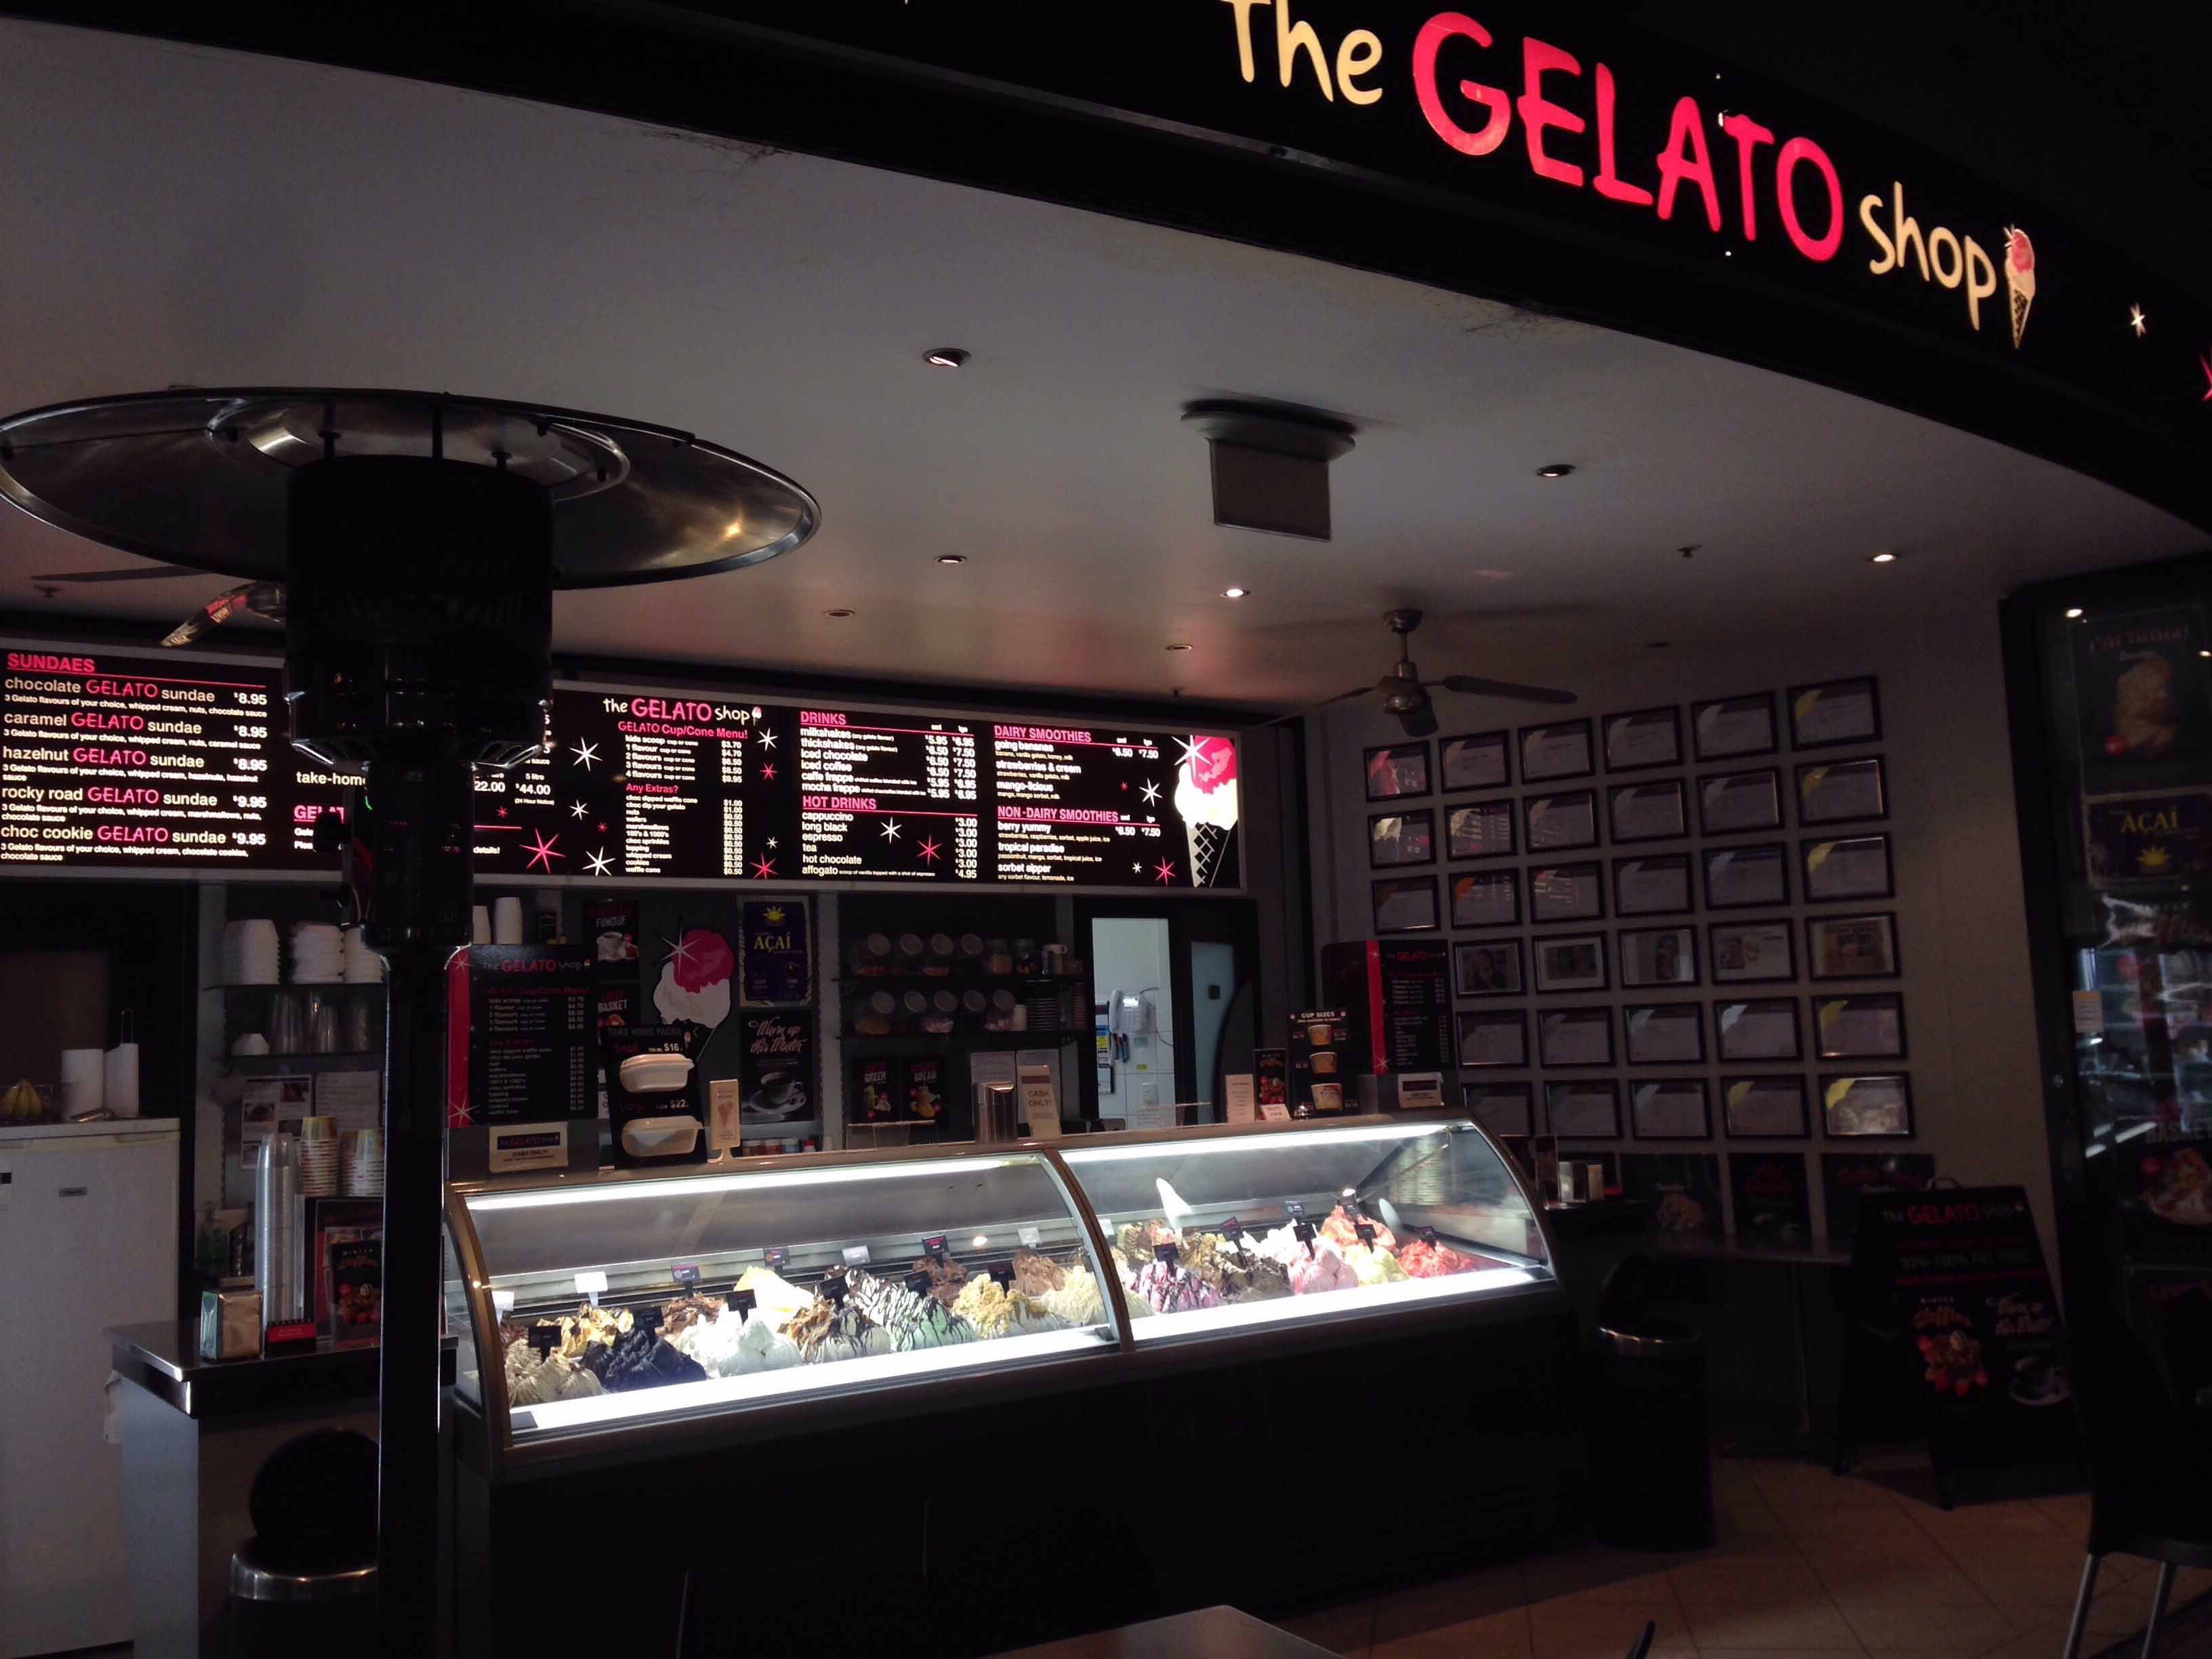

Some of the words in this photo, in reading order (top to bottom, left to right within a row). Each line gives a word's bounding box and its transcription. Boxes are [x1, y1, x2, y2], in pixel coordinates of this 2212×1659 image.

[1223, 0, 1383, 105] The
[1412, 12, 1843, 261] GELATO
[1860, 182, 1996, 331] shop
[8, 653, 95, 673] SUNDAES
[5, 677, 81, 693] chocolate
[86, 680, 158, 697] GELATO
[161, 689, 216, 702] sundae
[234, 692, 267, 705] $8.95
[12, 695, 37, 703] Gelato
[39, 696, 70, 705] flavours
[603, 699, 628, 712] the
[632, 698, 712, 721] GELATO
[714, 705, 750, 725] shop
[800, 711, 846, 725] DRINKS
[4, 713, 67, 726] caramel
[71, 712, 144, 730] GELATO
[148, 721, 202, 734] sundae
[234, 724, 267, 738] $8.95
[618, 721, 659, 733] GELATO
[661, 724, 714, 737] Cup/Cone
[716, 729, 748, 739] Menu!
[800, 726, 851, 739] milkshakes
[994, 725, 1027, 737] DAIRY
[1029, 727, 1091, 743] SMOOTHIES
[632, 743, 658, 752] flavour
[642, 737, 665, 745] scoop
[801, 737, 855, 750] thickshakes
[995, 739, 1018, 752] going
[1018, 741, 1054, 752] bananas
[3, 745, 69, 761] hazelnut
[73, 748, 146, 765] GELATO
[150, 754, 205, 768] sundae
[632, 752, 662, 761] flavours
[801, 748, 821, 758] iced
[823, 750, 868, 762] chocolate
[632, 761, 662, 770] flavours
[801, 760, 821, 770] iced
[823, 761, 853, 772] coffee
[996, 760, 1046, 771] strawberries
[1056, 764, 1082, 774] cream
[632, 770, 662, 779] flavours
[515, 783, 551, 795] $44.00
[626, 783, 643, 794] Any
[646, 784, 679, 793] Extras?
[1, 786, 45, 802] rocky
[49, 788, 83, 800] road
[87, 787, 159, 804] GELATO
[163, 793, 218, 806] sundae
[232, 795, 267, 808] $9.95
[802, 796, 828, 808] HOT
[831, 798, 877, 810] DRINKS
[802, 812, 854, 822] cappuccino
[955, 817, 978, 827] $3.00
[998, 806, 1021, 818] NON
[1059, 808, 1118, 822] SMOOTHIES
[802, 821, 822, 834] long
[823, 822, 848, 832] black
[955, 827, 978, 838] $3.00
[998, 821, 1020, 833] berry
[1021, 823, 1051, 834] yummy
[1, 825, 39, 838] choc
[43, 826, 93, 840] cookie
[98, 825, 168, 842] GELATO
[172, 830, 226, 844] sundae
[232, 832, 266, 845] $9.95
[802, 833, 843, 842] espresso
[955, 838, 978, 848] $3.00
[802, 843, 817, 853] tea
[955, 848, 977, 858] $3.00
[998, 842, 1029, 853] tropical
[1029, 843, 1065, 853] paradise
[802, 854, 818, 863] hot
[819, 855, 862, 865] chocolate
[955, 858, 977, 868] $3.00
[802, 865, 838, 877] affogato
[955, 869, 977, 879] $4.95
[998, 863, 1025, 872] sorbet
[1026, 863, 1051, 874] sipper
[501, 960, 557, 974] GELATO
